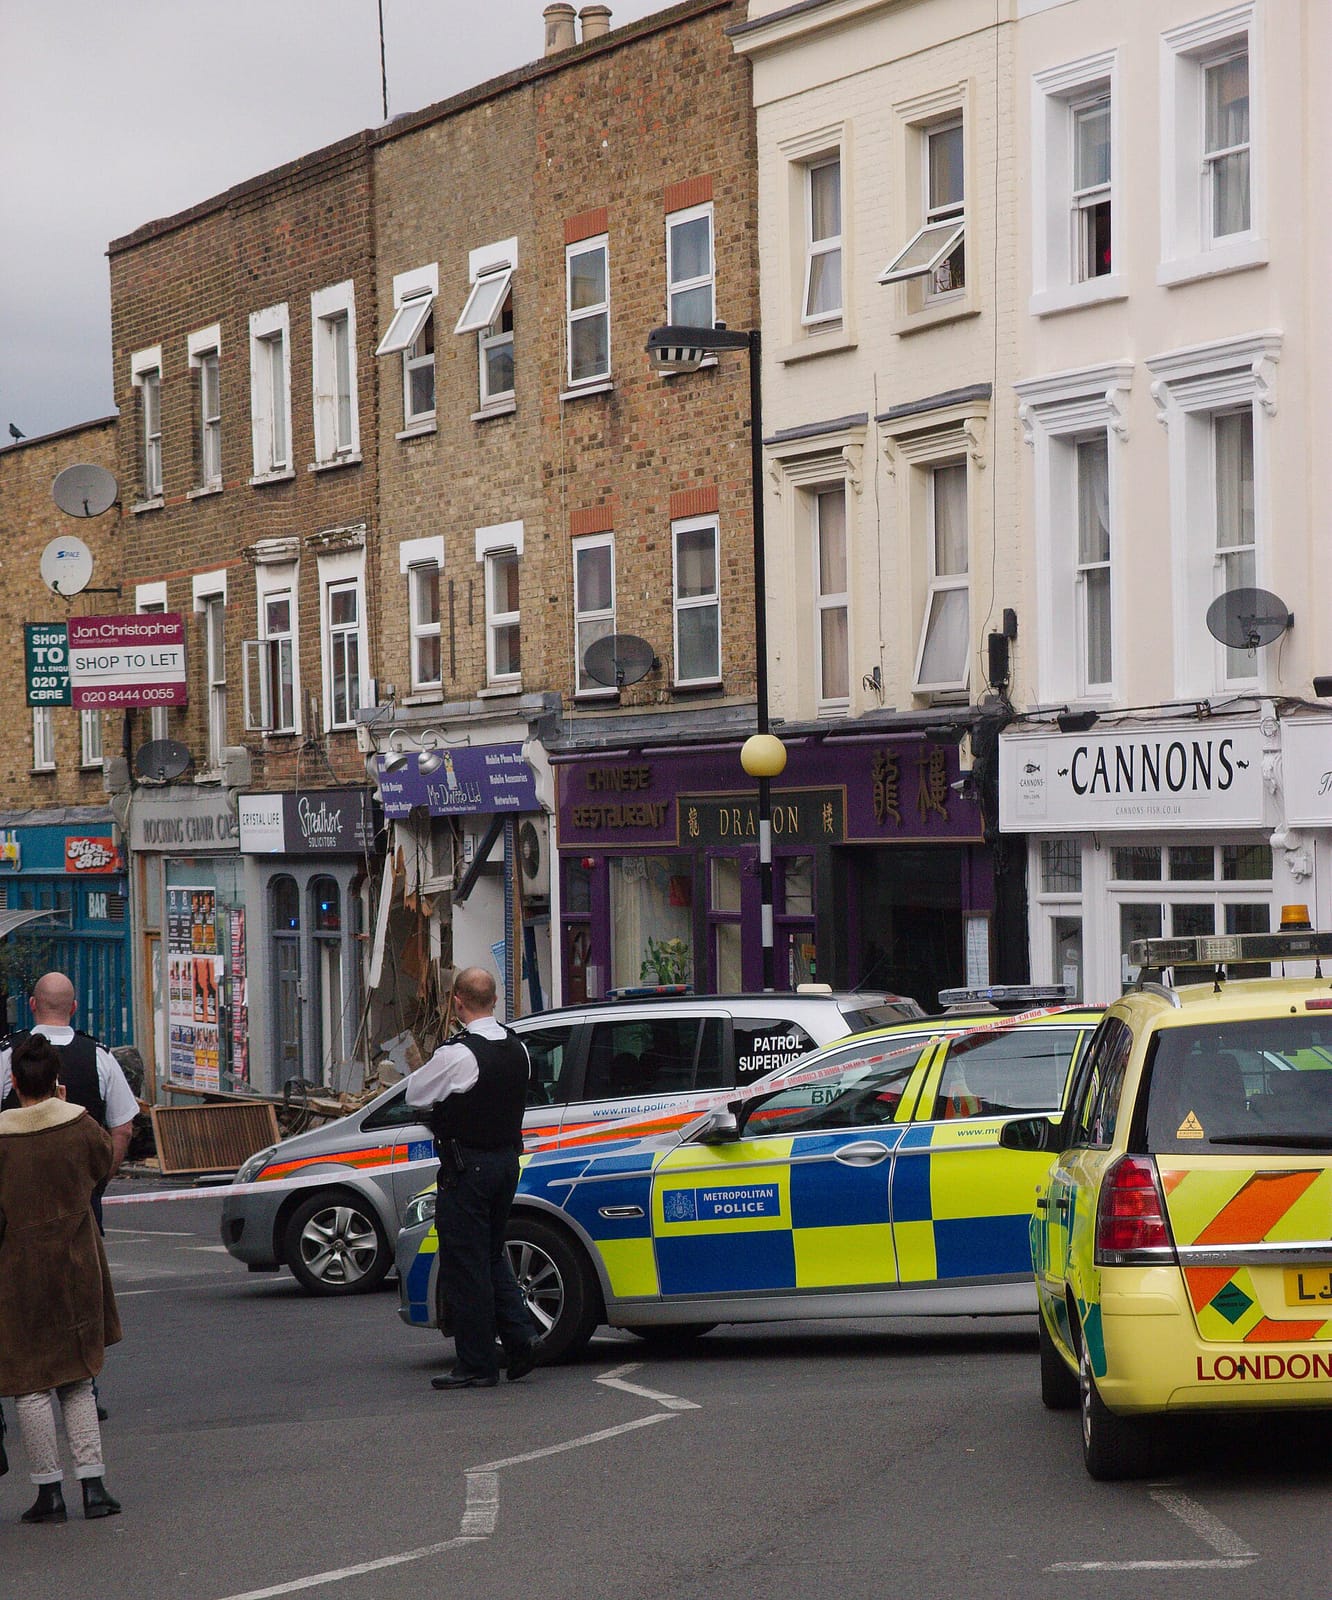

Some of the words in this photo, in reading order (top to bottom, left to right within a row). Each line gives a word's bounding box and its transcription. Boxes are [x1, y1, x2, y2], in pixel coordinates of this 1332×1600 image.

[72, 626, 99, 638] Jon
[100, 623, 180, 637] Christopher
[32, 634, 67, 645] SHOP
[32, 647, 64, 664] TO
[76, 656, 120, 670] SHOP
[124, 654, 146, 667] TO
[150, 653, 178, 666] LET
[32, 677, 58, 688] 020
[30, 690, 64, 700] CBRE
[82, 692, 106, 703] 020
[108, 690, 141, 701] 8444
[142, 689, 175, 700] 0055
[1071, 739, 1234, 796] CANNONS
[586, 764, 650, 792] CHINESE
[242, 813, 266, 826] CRYSTAL
[266, 813, 280, 825] LIFE
[571, 803, 669, 829] RESTAURANT
[719, 806, 799, 837] DRAON
[143, 816, 184, 844] ROCKING
[186, 815, 215, 842] CHAIR
[68, 839, 104, 859] Kiss
[308, 837, 337, 848] SOLICITORS
[75, 854, 111, 869] Bar
[88, 892, 108, 919] BAR
[753, 1034, 803, 1052] PATROL
[738, 1052, 808, 1072] SUPERVIS
[703, 1189, 773, 1202] METROPOLITAN
[714, 1202, 765, 1214] POLICE
[1196, 1354, 1332, 1382] LONDON
